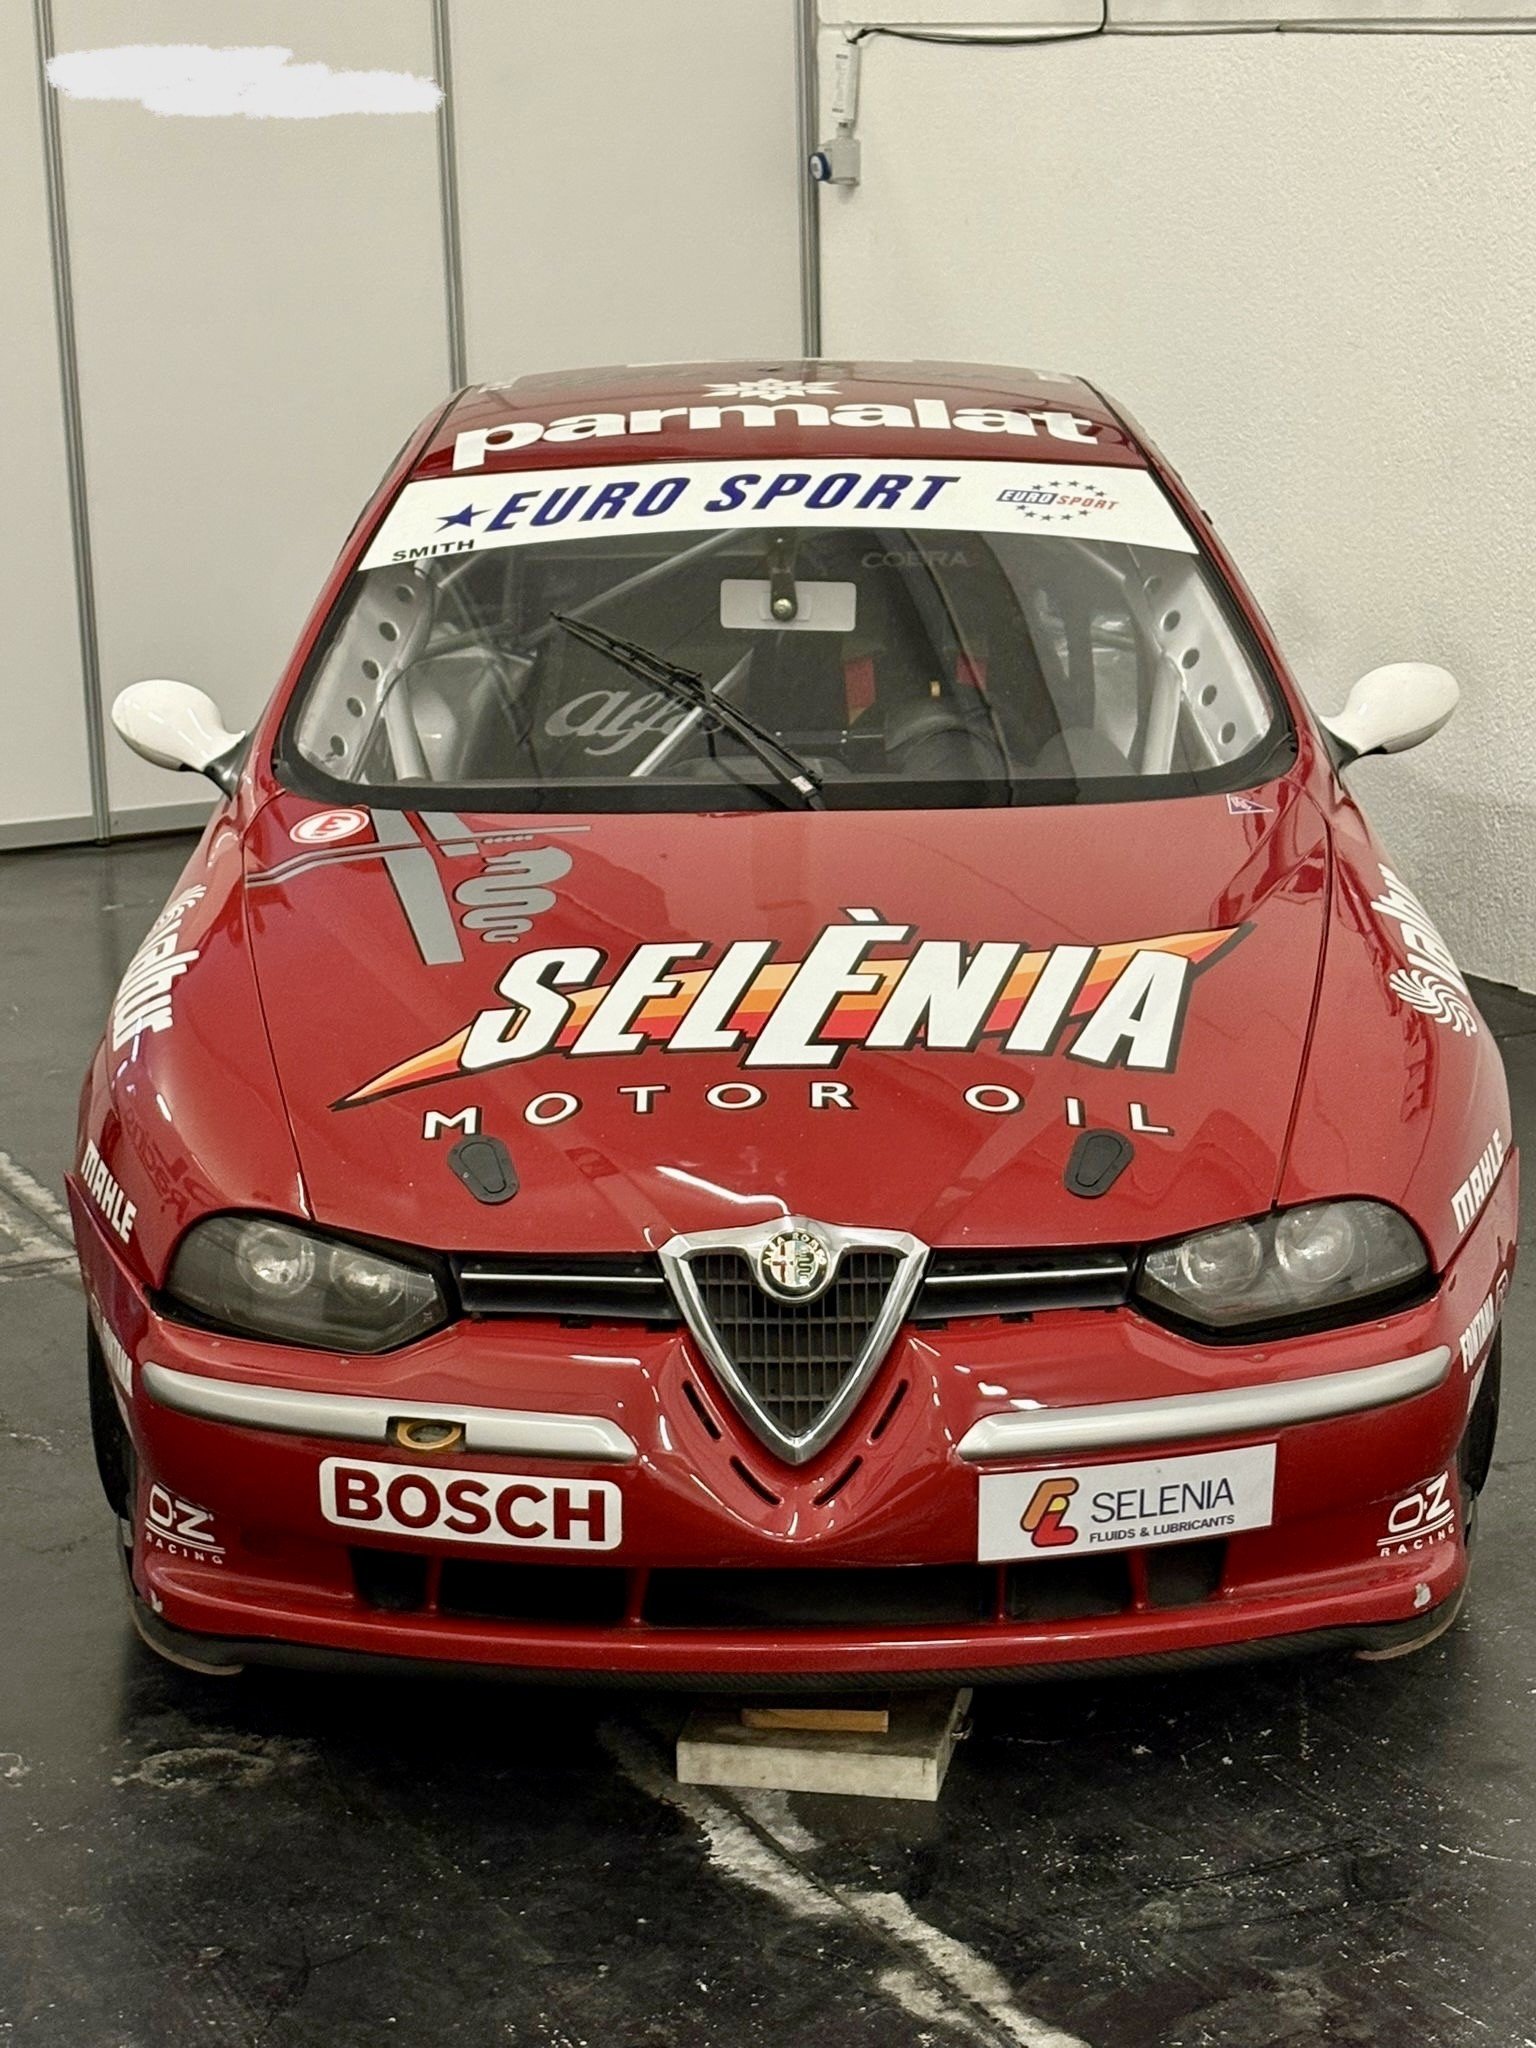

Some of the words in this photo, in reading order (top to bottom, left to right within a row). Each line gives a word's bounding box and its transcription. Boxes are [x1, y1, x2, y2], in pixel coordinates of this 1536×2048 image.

[452, 399, 1098, 471] parmalat
[483, 476, 691, 533] EURO
[704, 471, 962, 512] SPORT
[1001, 490, 1054, 504] EURO
[1056, 495, 1119, 510] SPORT
[391, 539, 475, 562] SMITH
[460, 906, 1192, 1073] SELÈNIA
[422, 1080, 859, 1140] MOTOR
[963, 1083, 1177, 1137] OIL
[80, 1138, 138, 1245] MAHLE
[1450, 1127, 1504, 1235] MAHLE
[334, 1466, 606, 1543] BOSCH
[1089, 1527, 1136, 1543] FLUIDS
[1140, 1526, 1150, 1538] &
[1153, 1514, 1235, 1536] LUBRICANTS
[1090, 1477, 1235, 1524] SELENIA
[145, 1531, 223, 1564] RACING
[1380, 1523, 1456, 1558] RACING
